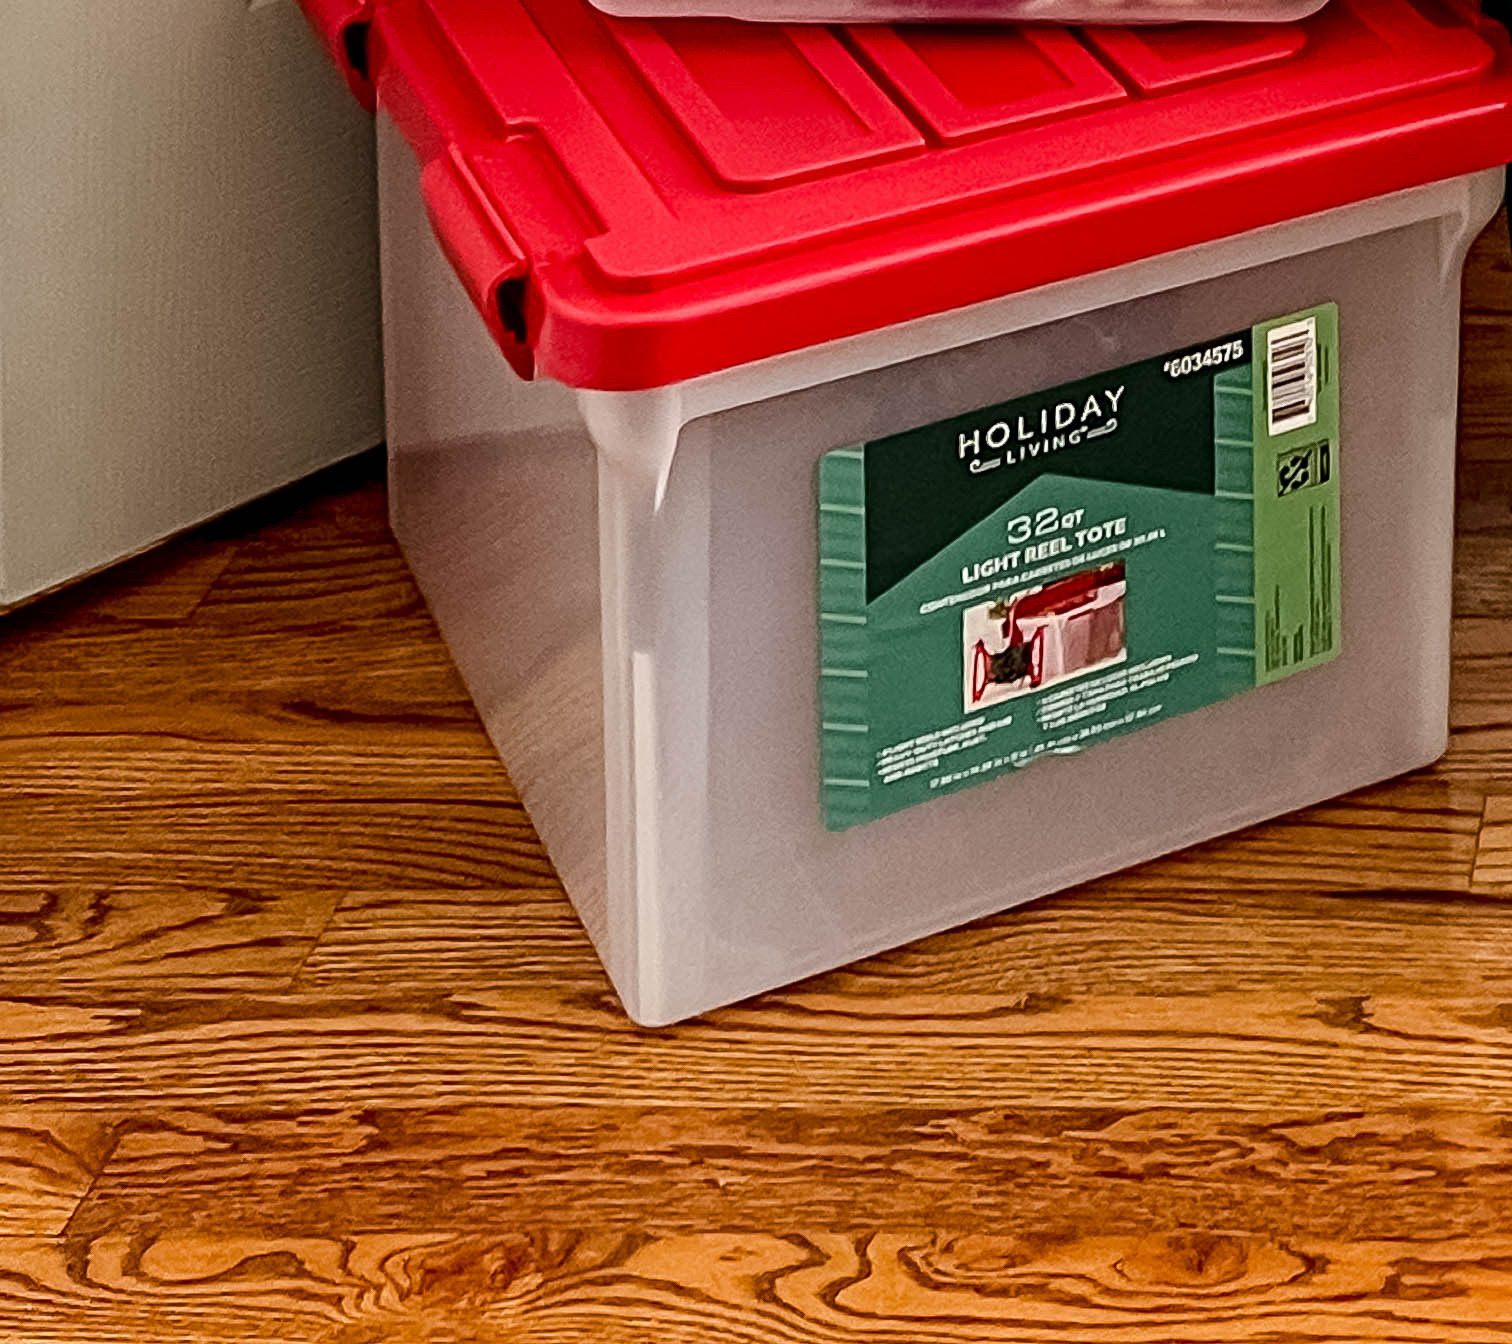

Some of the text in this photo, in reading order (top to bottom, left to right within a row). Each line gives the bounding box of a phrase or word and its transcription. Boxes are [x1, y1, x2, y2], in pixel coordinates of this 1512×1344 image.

[958, 384, 1126, 460] HOLIDAY
[1005, 425, 1089, 466] LIVING
[961, 549, 1022, 585] LIGHT
[1024, 536, 1074, 565] REEL
[1074, 516, 1128, 548] TOTE
